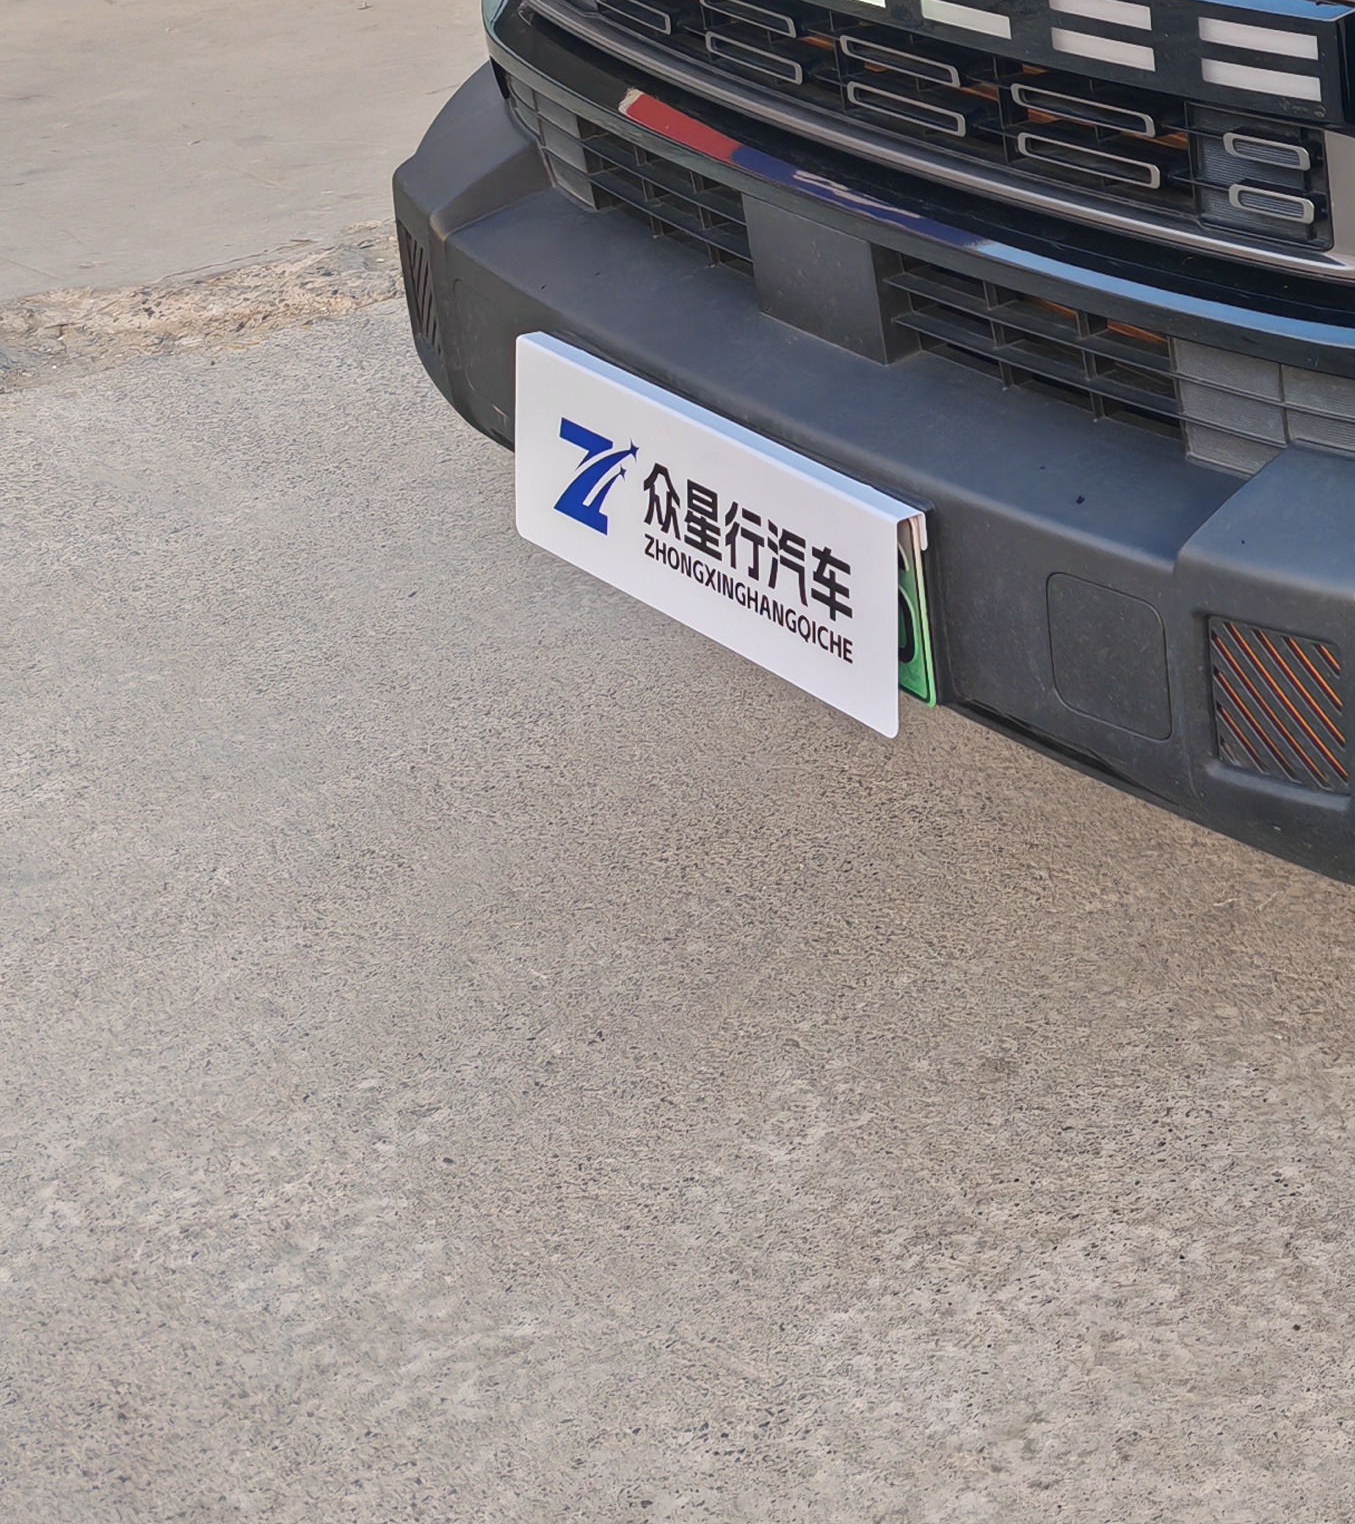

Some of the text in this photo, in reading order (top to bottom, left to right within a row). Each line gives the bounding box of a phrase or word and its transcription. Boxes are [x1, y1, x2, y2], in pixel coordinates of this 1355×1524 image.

[642, 462, 854, 622] 众星行汽车
[644, 533, 854, 664] ZHONGXINGHANGQICHE
